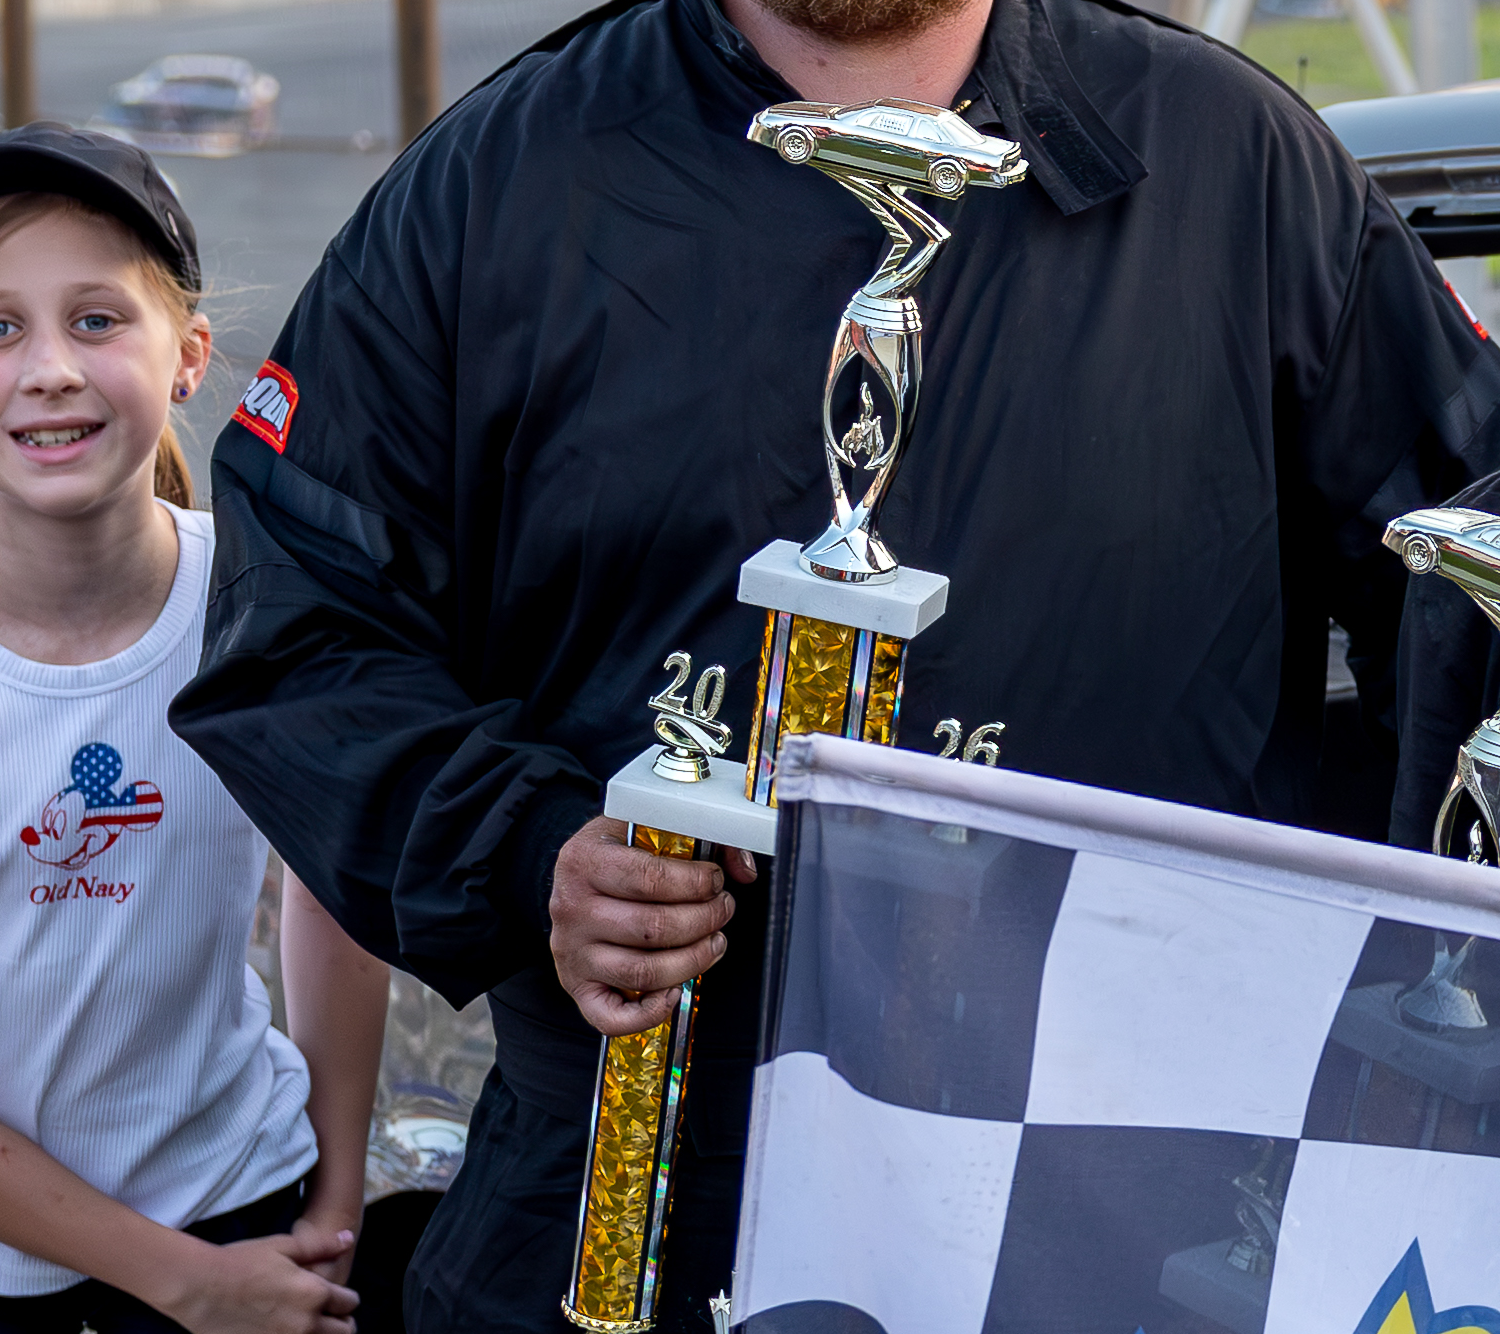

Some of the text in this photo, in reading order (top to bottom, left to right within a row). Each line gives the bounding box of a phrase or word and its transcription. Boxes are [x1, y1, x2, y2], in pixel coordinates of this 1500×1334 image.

[648, 650, 727, 720] 20
[933, 717, 1006, 767] 26
[30, 875, 135, 905] Old Navy
